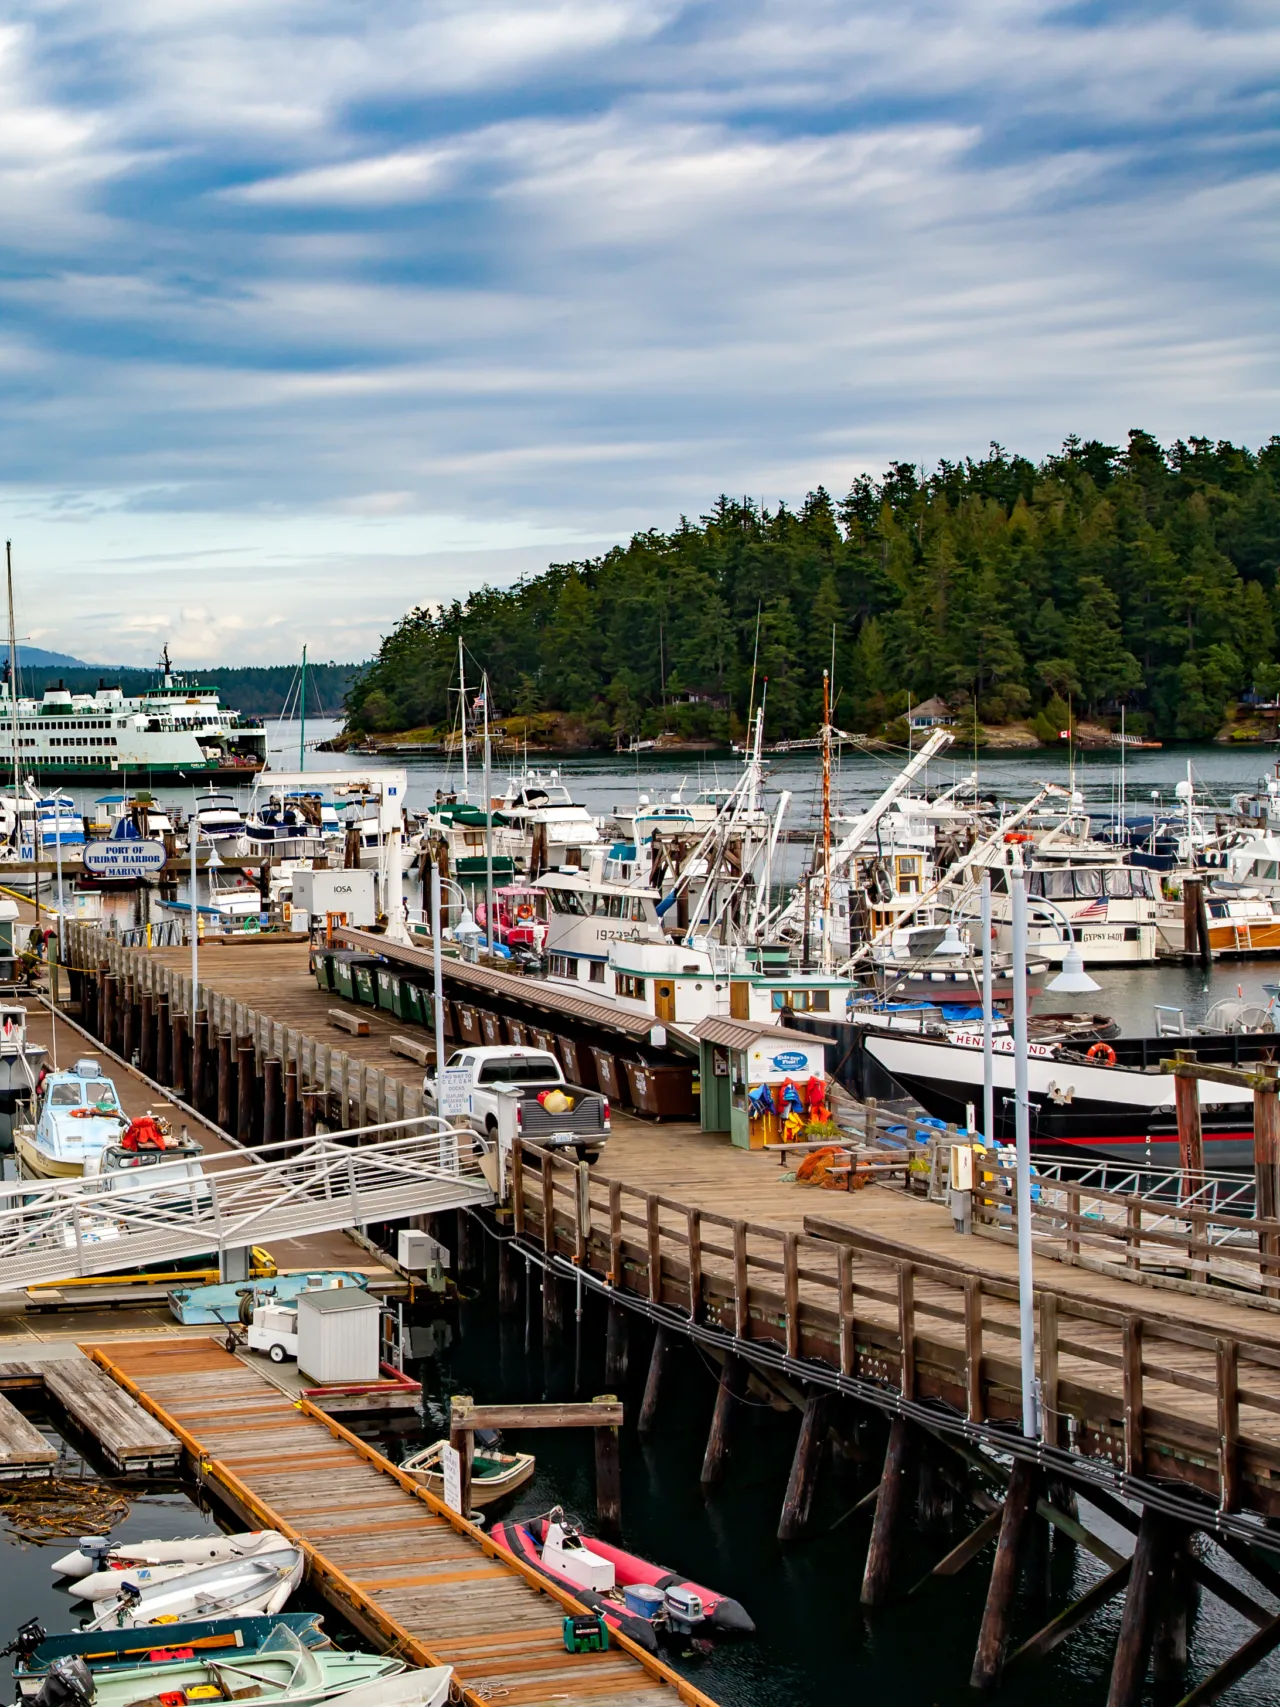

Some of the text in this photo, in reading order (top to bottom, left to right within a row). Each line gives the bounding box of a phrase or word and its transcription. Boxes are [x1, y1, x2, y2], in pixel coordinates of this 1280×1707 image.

[21, 847, 32, 858] M
[105, 846, 144, 854] PORT OF
[88, 855, 160, 864] FRIDAY HARBOR
[108, 868, 142, 876] MARINA
[1083, 932, 1123, 942] GYPSY LADY
[956, 1035, 1046, 1055] HENY ISND
[1145, 1135, 1151, 1143] 5
